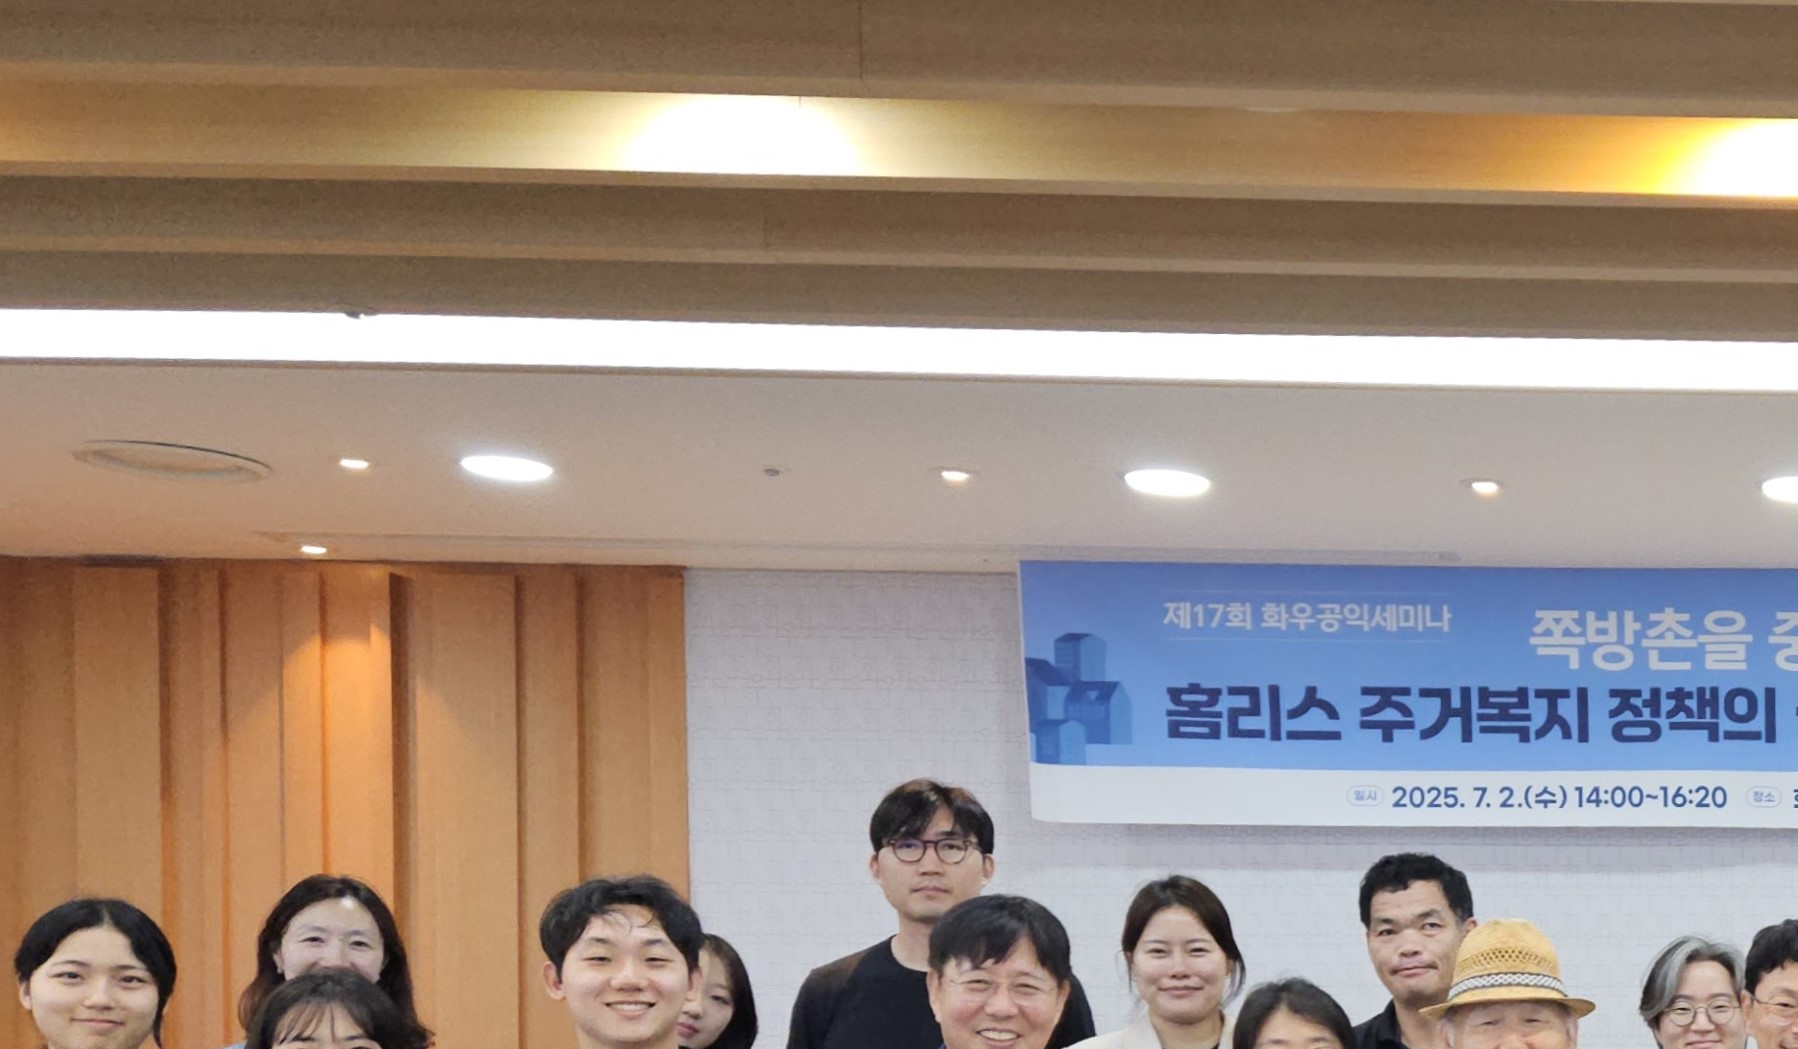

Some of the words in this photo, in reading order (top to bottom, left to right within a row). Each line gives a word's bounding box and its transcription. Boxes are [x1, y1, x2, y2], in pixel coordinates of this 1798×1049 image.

[1163, 602, 1252, 630] 제17회
[1260, 602, 1452, 632] 화우공익세미나
[1529, 608, 1753, 672] 쪽방촌을
[1166, 682, 1342, 742] 홈리스
[1360, 685, 1589, 743] 주거복지
[1608, 686, 1776, 743] 정책의
[1353, 789, 1378, 802] 일시
[1391, 786, 1465, 808] 2025.
[1473, 787, 1491, 808] 7.
[1574, 785, 1727, 808] 14:00~16:20
